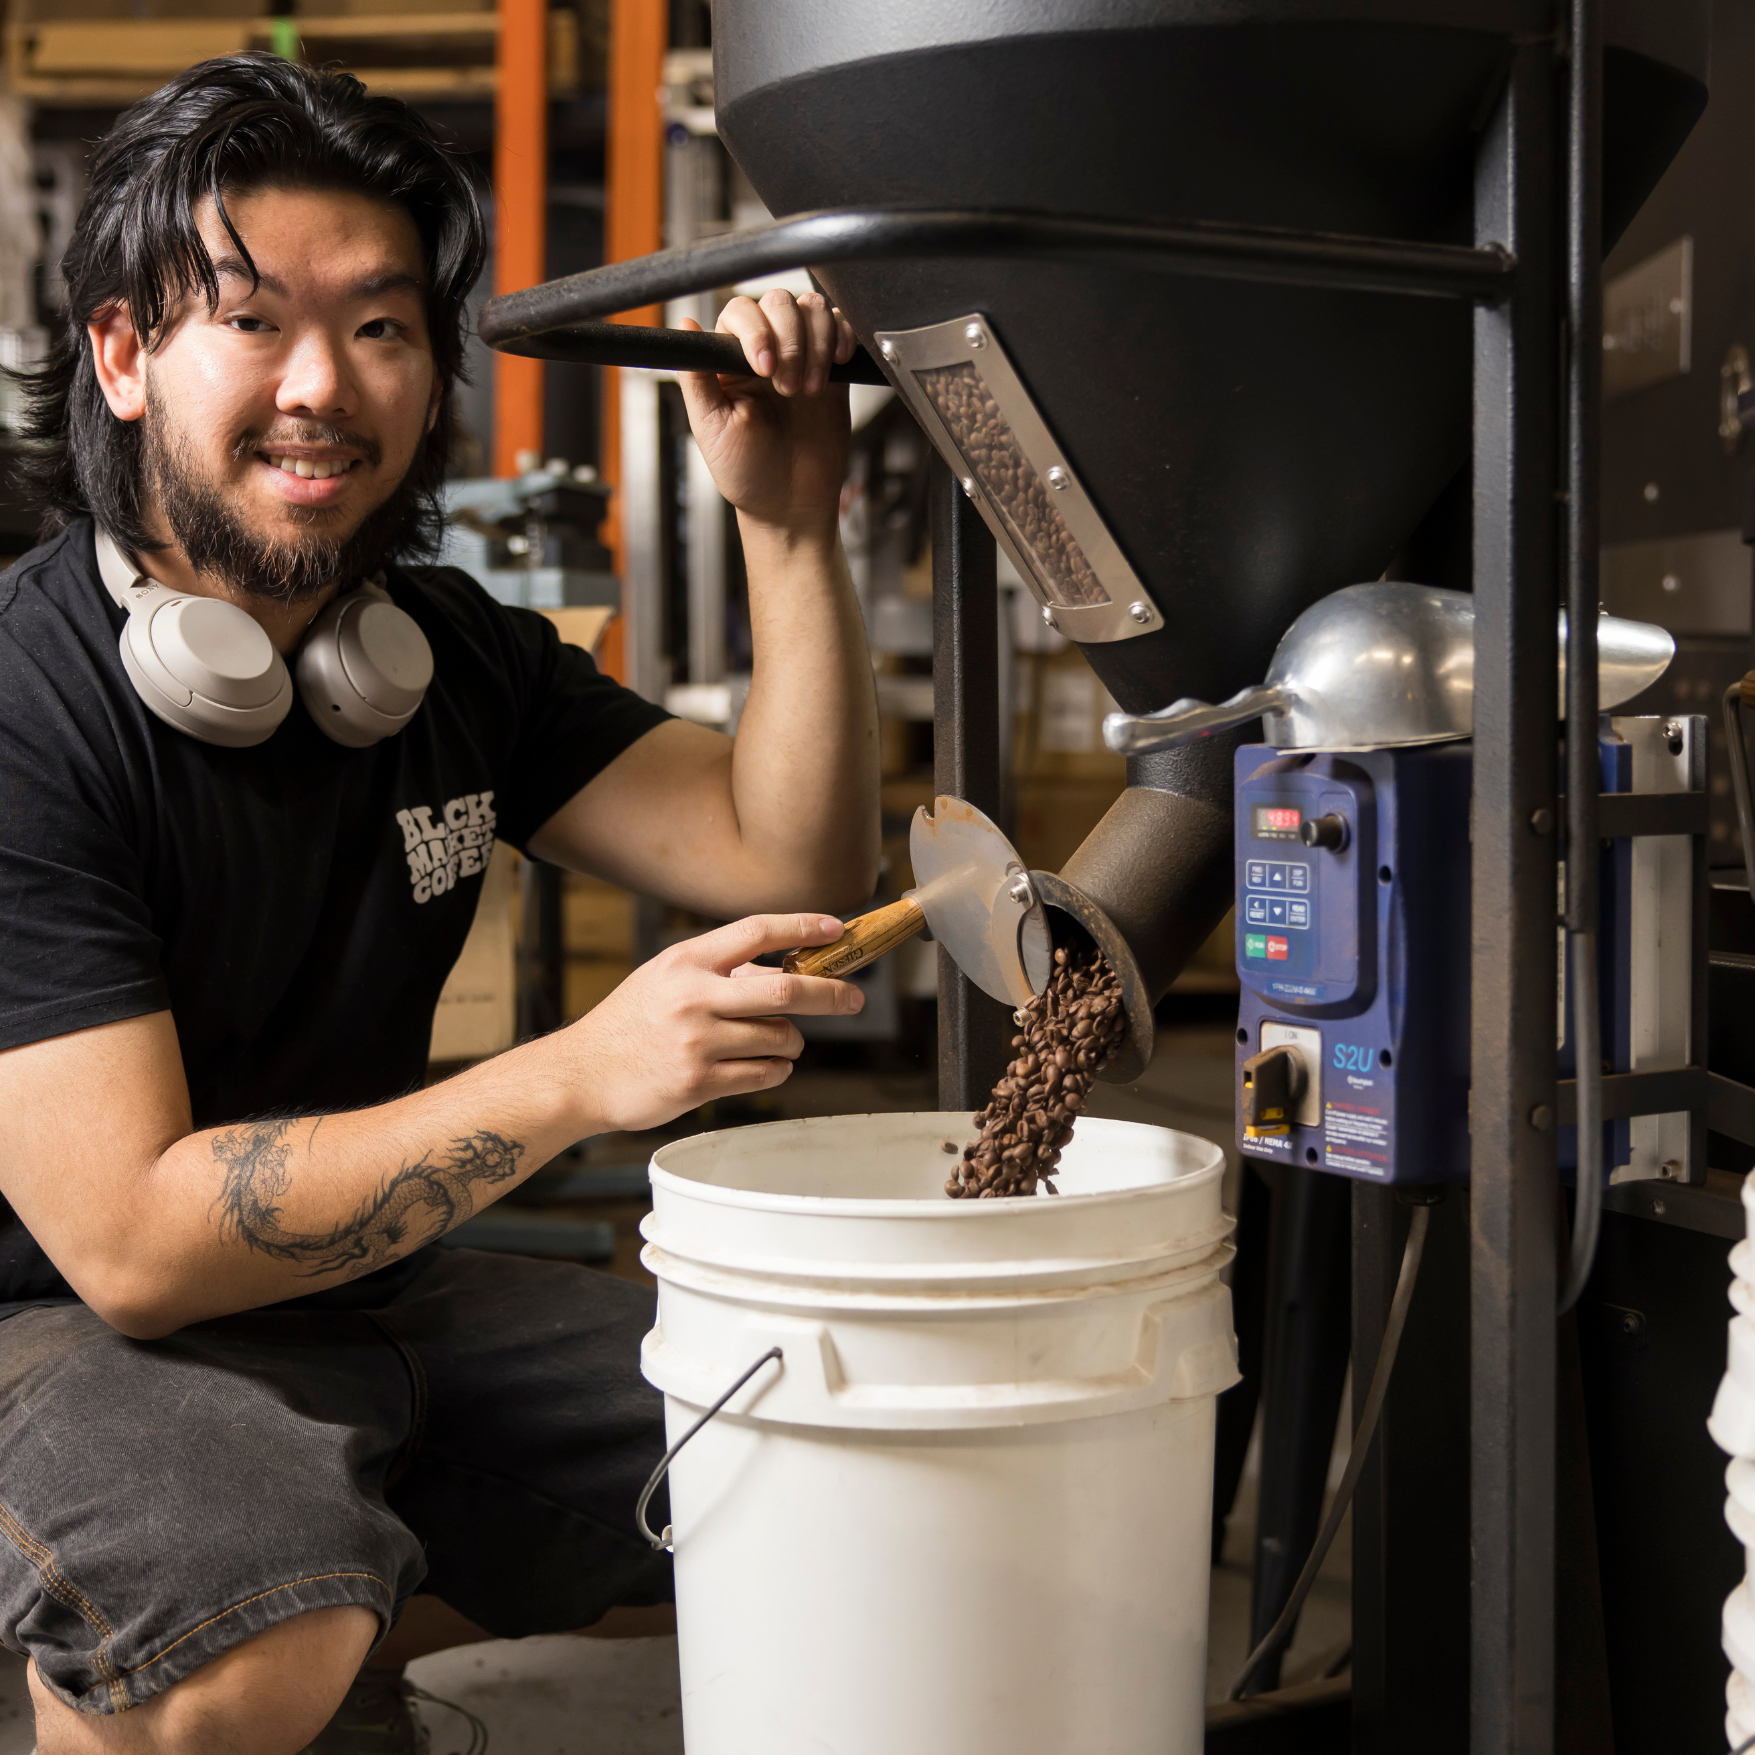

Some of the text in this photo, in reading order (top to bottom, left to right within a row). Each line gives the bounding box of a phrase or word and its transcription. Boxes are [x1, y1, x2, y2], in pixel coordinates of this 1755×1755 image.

[135, 583, 160, 600] SONY
[396, 790, 497, 853] BLCK
[407, 819, 497, 885] MAKET
[1333, 1043, 1374, 1073] S2U
[1264, 1137, 1283, 1148] NEMA
